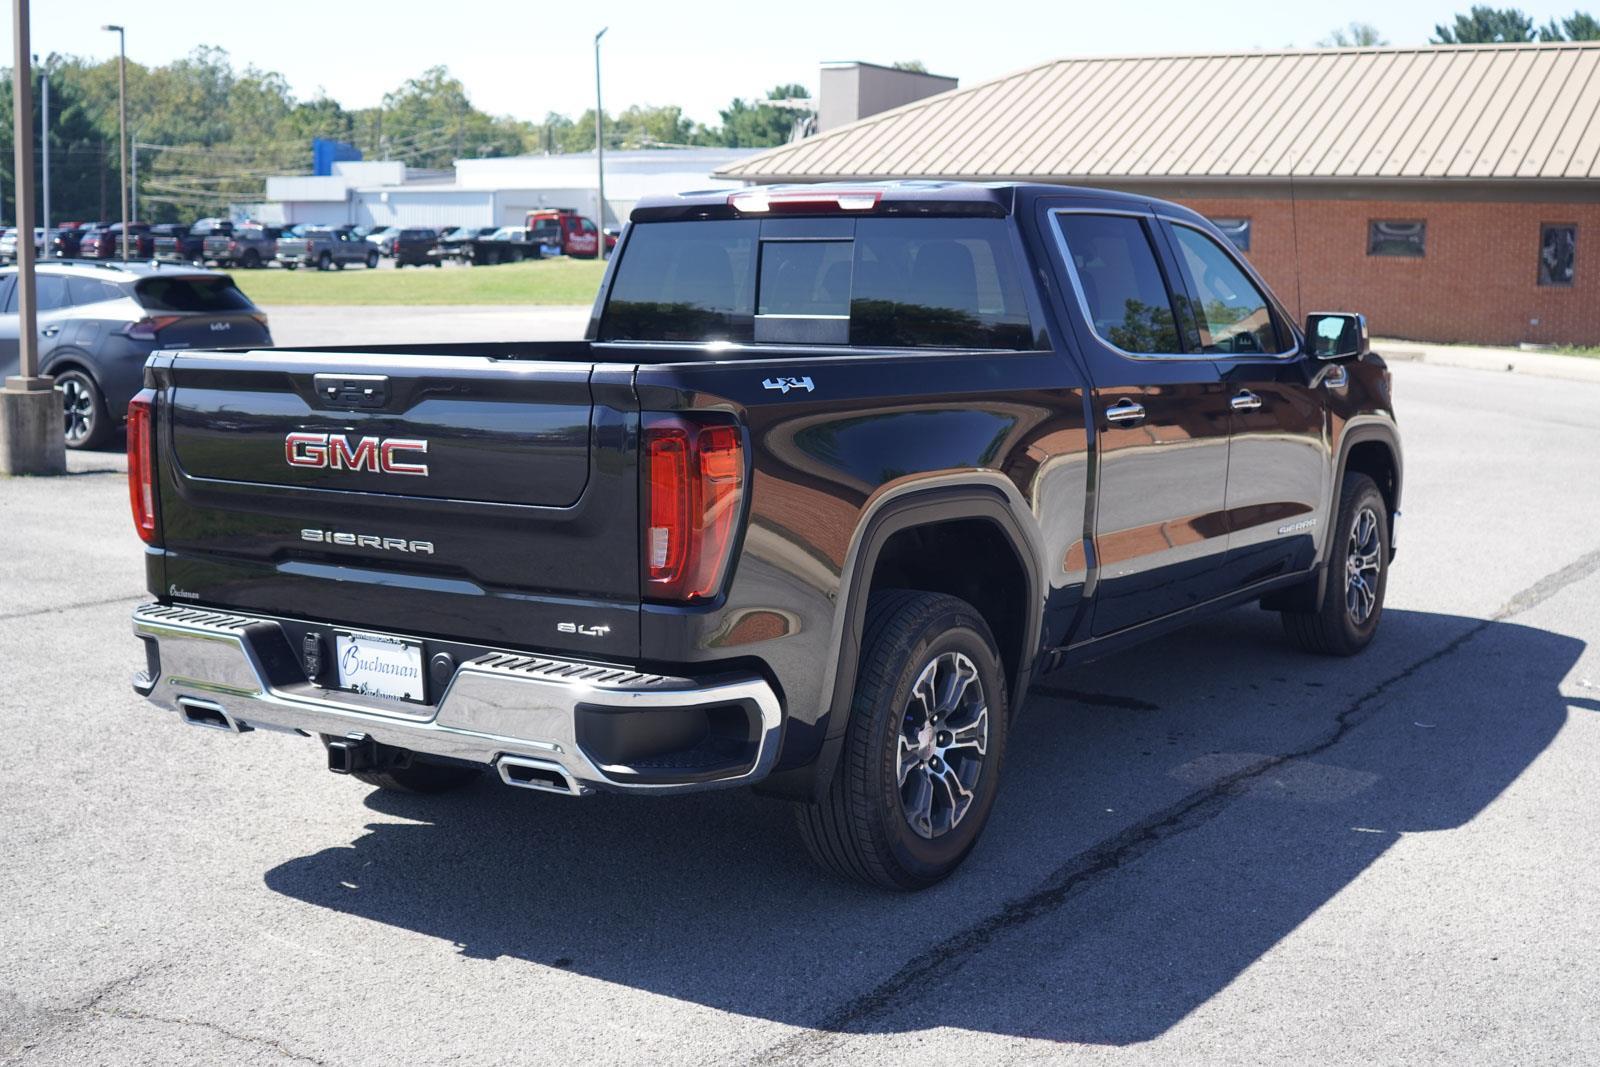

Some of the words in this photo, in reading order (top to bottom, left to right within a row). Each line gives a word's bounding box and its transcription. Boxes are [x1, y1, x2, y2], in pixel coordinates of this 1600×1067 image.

[285, 431, 428, 476] GMC
[1279, 519, 1317, 533] SIERRA
[300, 528, 435, 555] SIERRA
[169, 584, 200, 599] Buchanan
[557, 622, 611, 636] SLT
[343, 645, 418, 678] Buchanan
